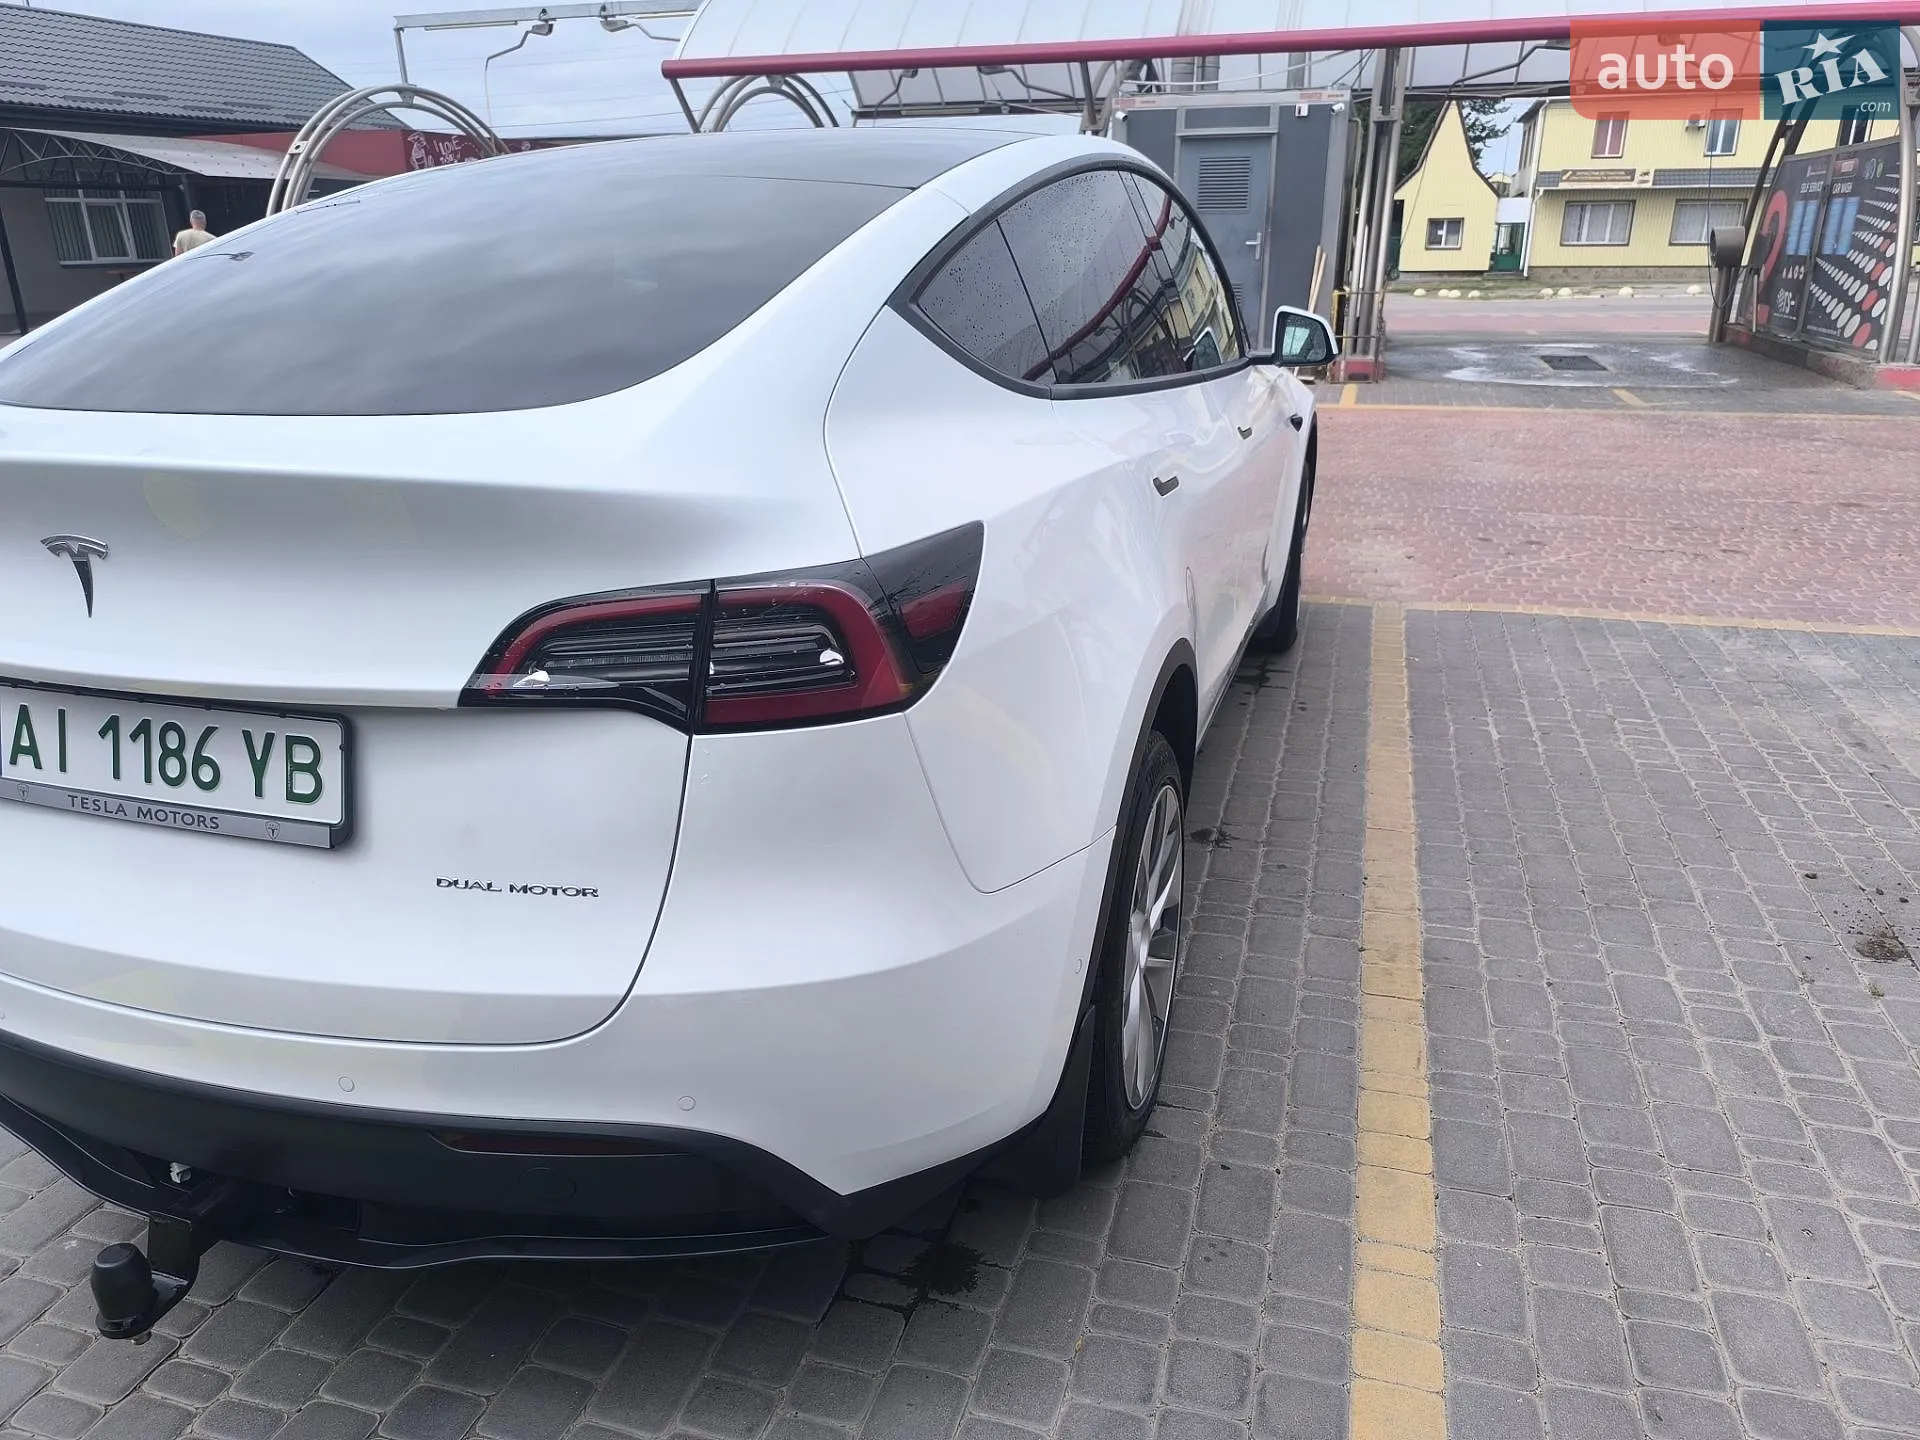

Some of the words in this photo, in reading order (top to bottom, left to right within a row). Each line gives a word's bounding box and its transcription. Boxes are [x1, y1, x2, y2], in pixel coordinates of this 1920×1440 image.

[9, 703, 67, 773] AI
[98, 714, 221, 791] 1186
[242, 729, 323, 804] YB
[68, 794, 128, 817] TESLA
[136, 806, 220, 830] MOTORS
[436, 875, 502, 893] DUAL
[508, 882, 599, 898] MOTOR
